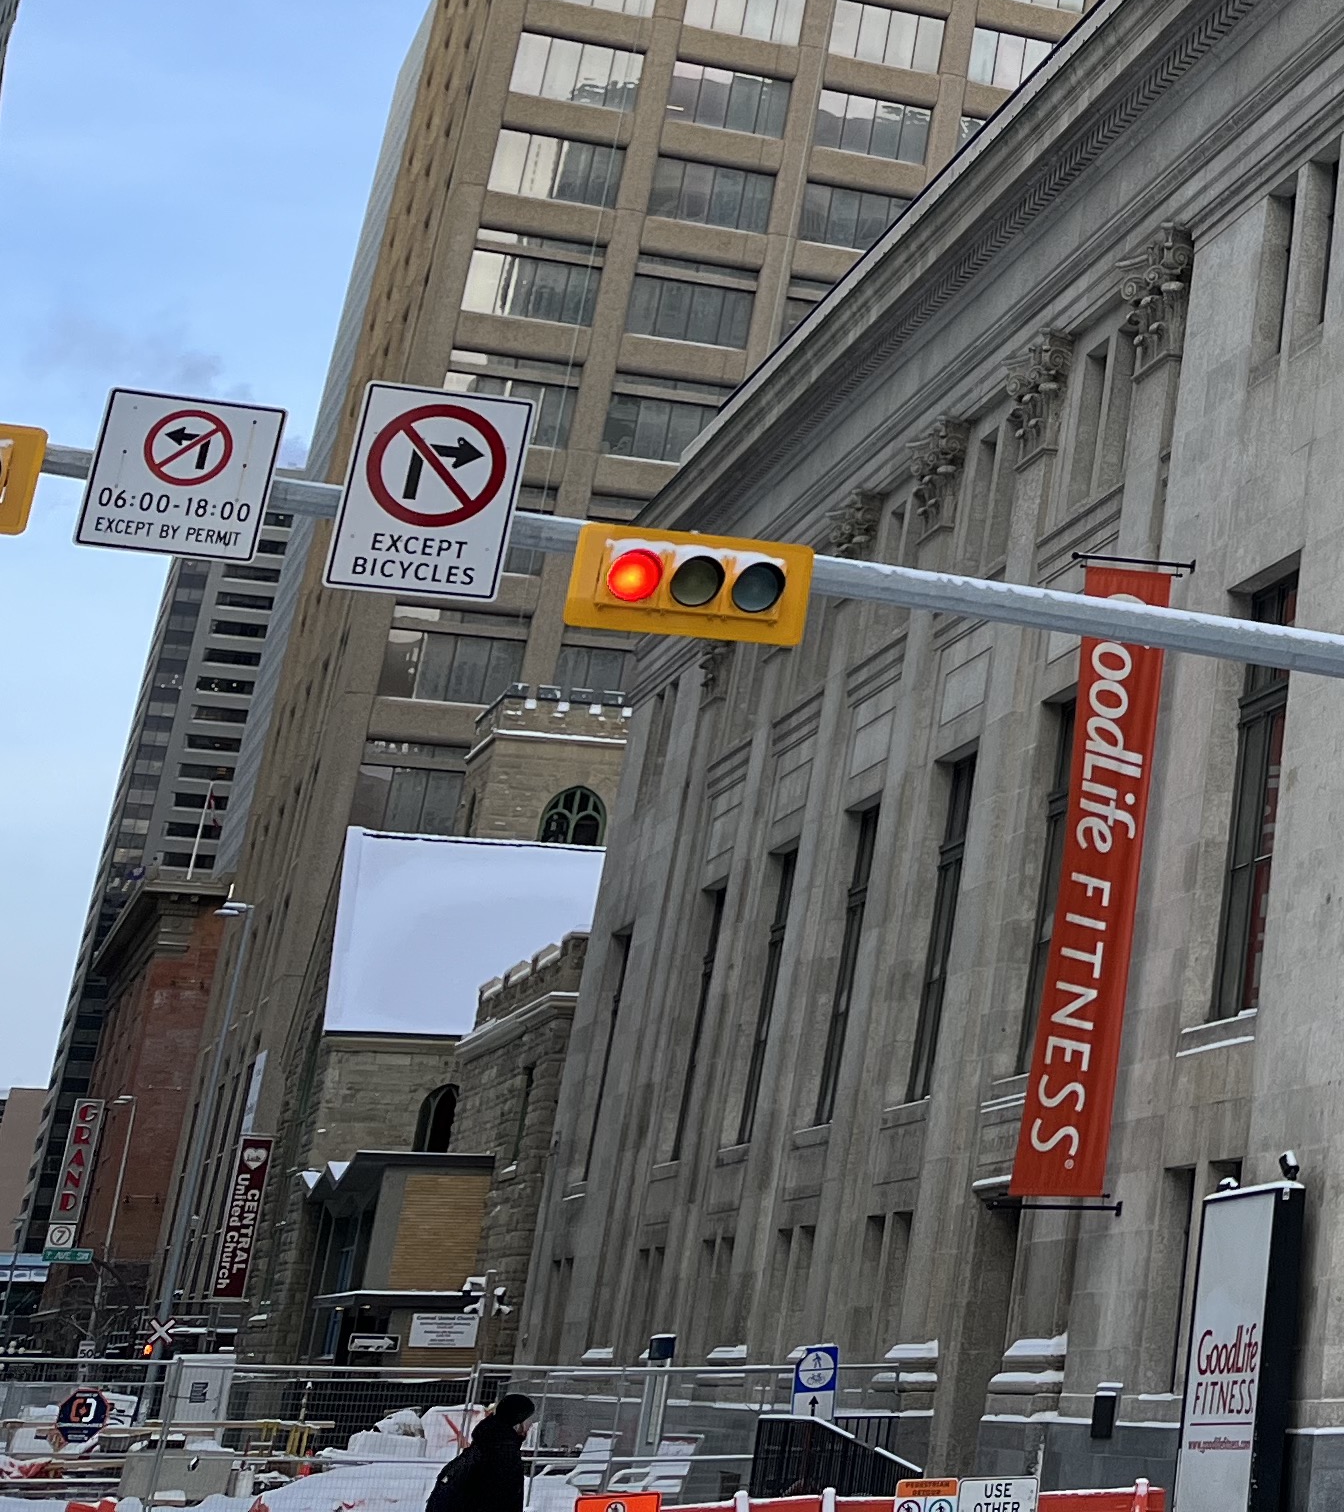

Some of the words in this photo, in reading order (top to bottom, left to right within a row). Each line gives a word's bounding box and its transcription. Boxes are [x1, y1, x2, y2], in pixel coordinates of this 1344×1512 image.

[97, 487, 251, 522] 06:00-18:00
[94, 516, 154, 537] EXCEPT
[158, 524, 181, 540] BY
[185, 527, 242, 547] PERMIT
[371, 532, 468, 559] EXCEPT
[351, 556, 476, 586] BICYCLES
[1075, 593, 1147, 855] oodLife
[1030, 871, 1112, 1159] FITNESS
[58, 1103, 98, 1212] GRAND
[229, 1173, 251, 1227] United
[56, 1228, 66, 1244] 7
[232, 1189, 260, 1274] CENTRAL
[216, 1231, 239, 1289] Church
[79, 1348, 94, 1358] 50
[1197, 1322, 1259, 1376] GoodLife
[1192, 1378, 1255, 1416] FITNESS
[973, 1501, 1021, 1512] OTHER
[984, 1483, 1013, 1498] USE
